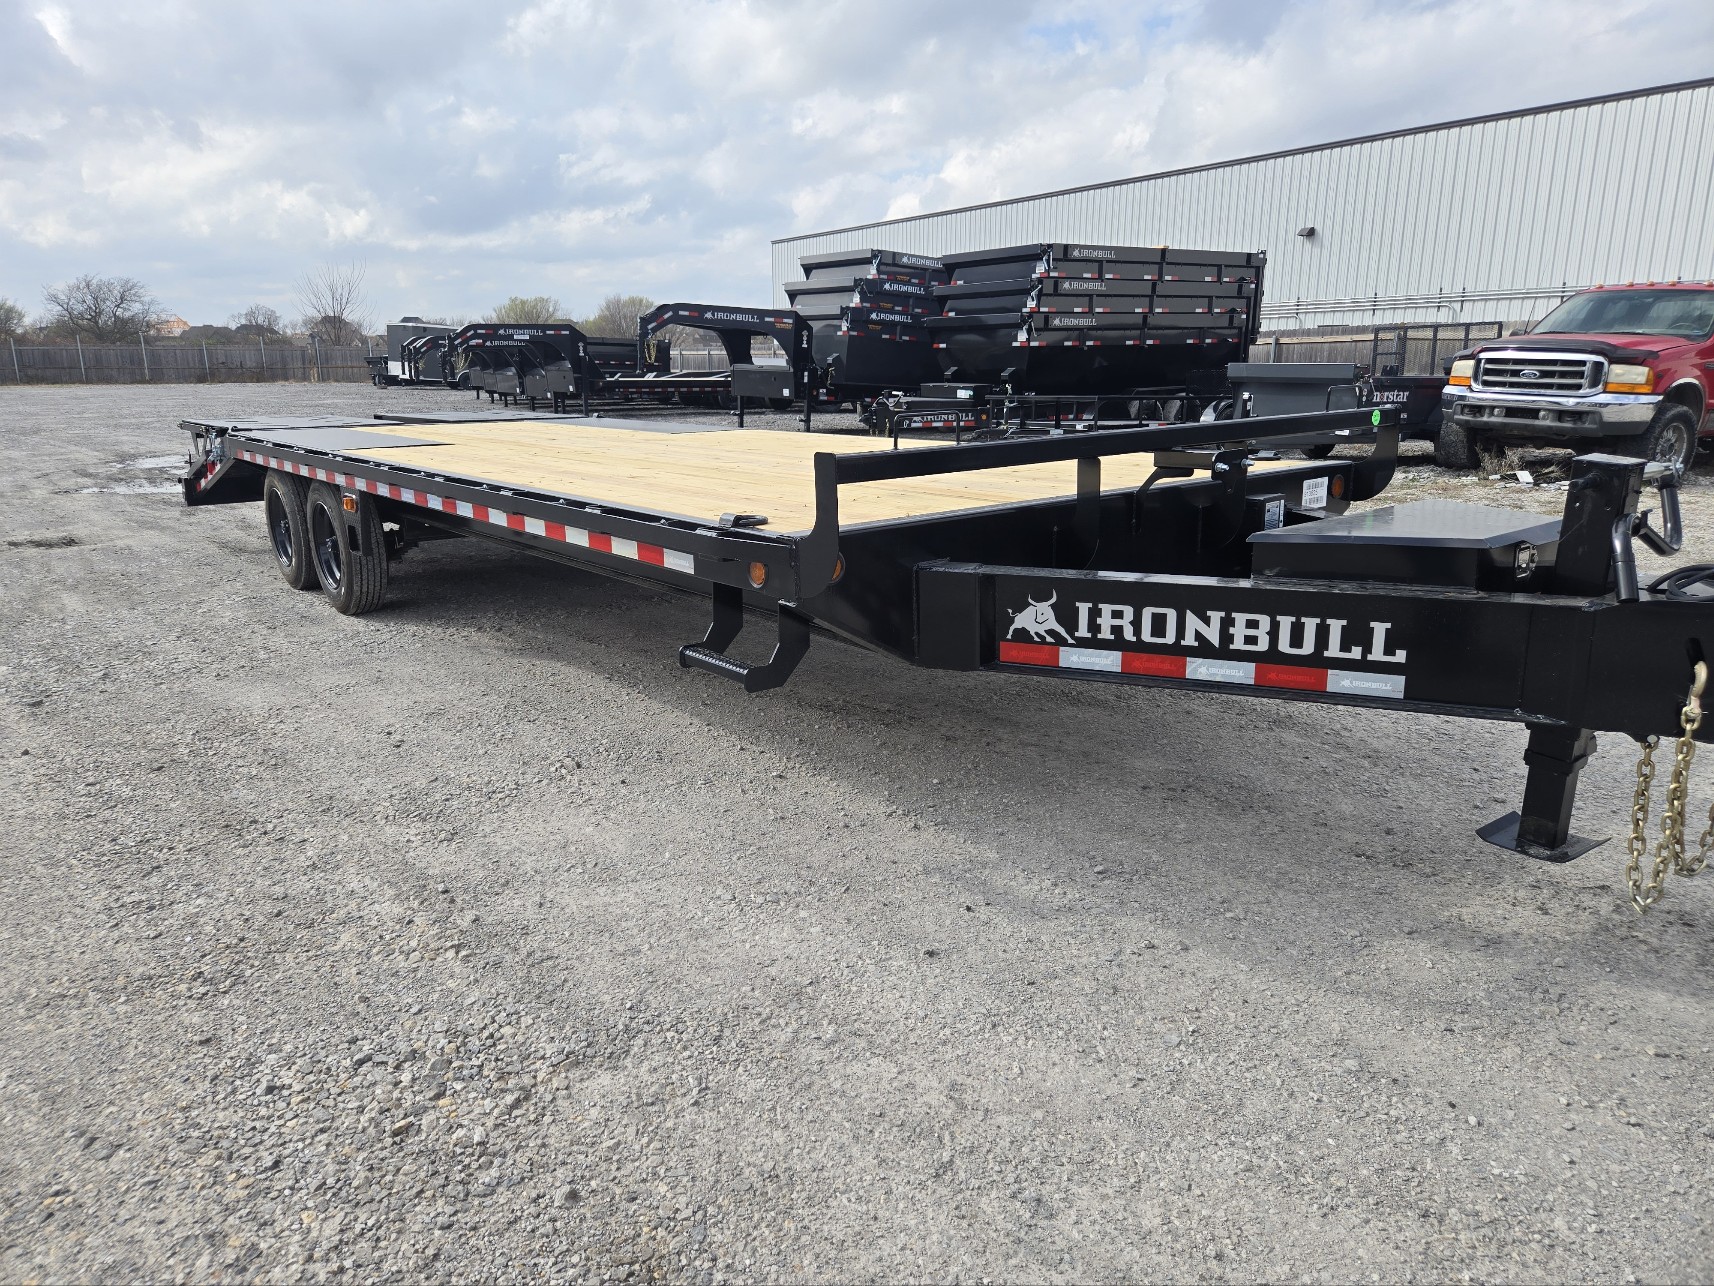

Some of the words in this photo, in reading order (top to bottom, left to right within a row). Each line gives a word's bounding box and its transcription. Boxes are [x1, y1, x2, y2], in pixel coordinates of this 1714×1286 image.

[1080, 249, 1116, 259] IRONBULL
[909, 256, 943, 268] IRONBULL
[891, 283, 925, 294] IRONBULL
[1070, 281, 1107, 290] IRONBULL
[714, 311, 760, 323] IRONBULL
[878, 313, 912, 323] IRONBULL
[1061, 318, 1097, 326] IRONBULL
[505, 328, 543, 336] IRONBULL
[1074, 601, 1407, 664] IRONBULL
[1351, 679, 1393, 690] IRONBULL
